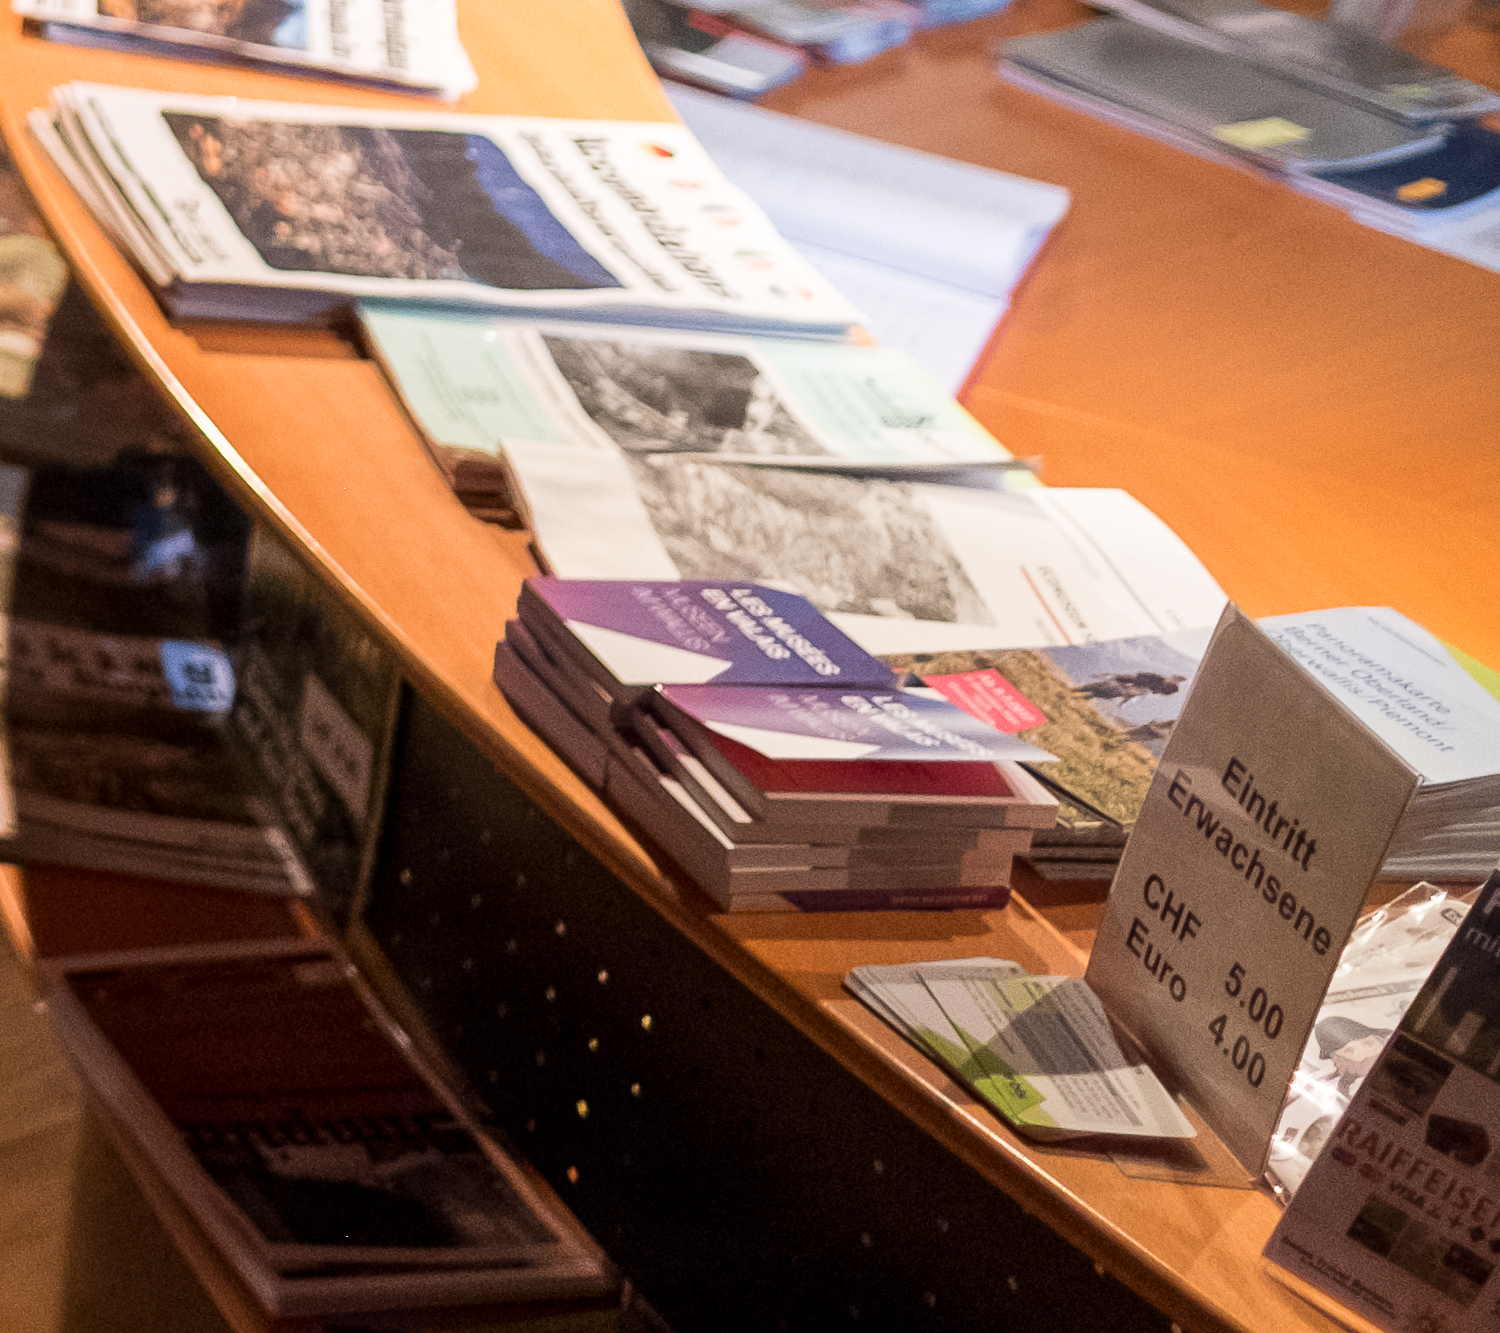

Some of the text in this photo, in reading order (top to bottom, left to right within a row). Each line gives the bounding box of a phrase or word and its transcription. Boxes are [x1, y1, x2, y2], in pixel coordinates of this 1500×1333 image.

[1304, 622, 1451, 715] Panoramakarte
[1368, 697, 1455, 753] Piemont
[1167, 768, 1333, 956] Erwachsene
[1221, 756, 1317, 872] Eintritt
[1124, 917, 1267, 1089] Euro 4.00
[1142, 873, 1285, 1040] CHF 5.00
[1338, 1116, 1500, 1230] RAIFFEISE
